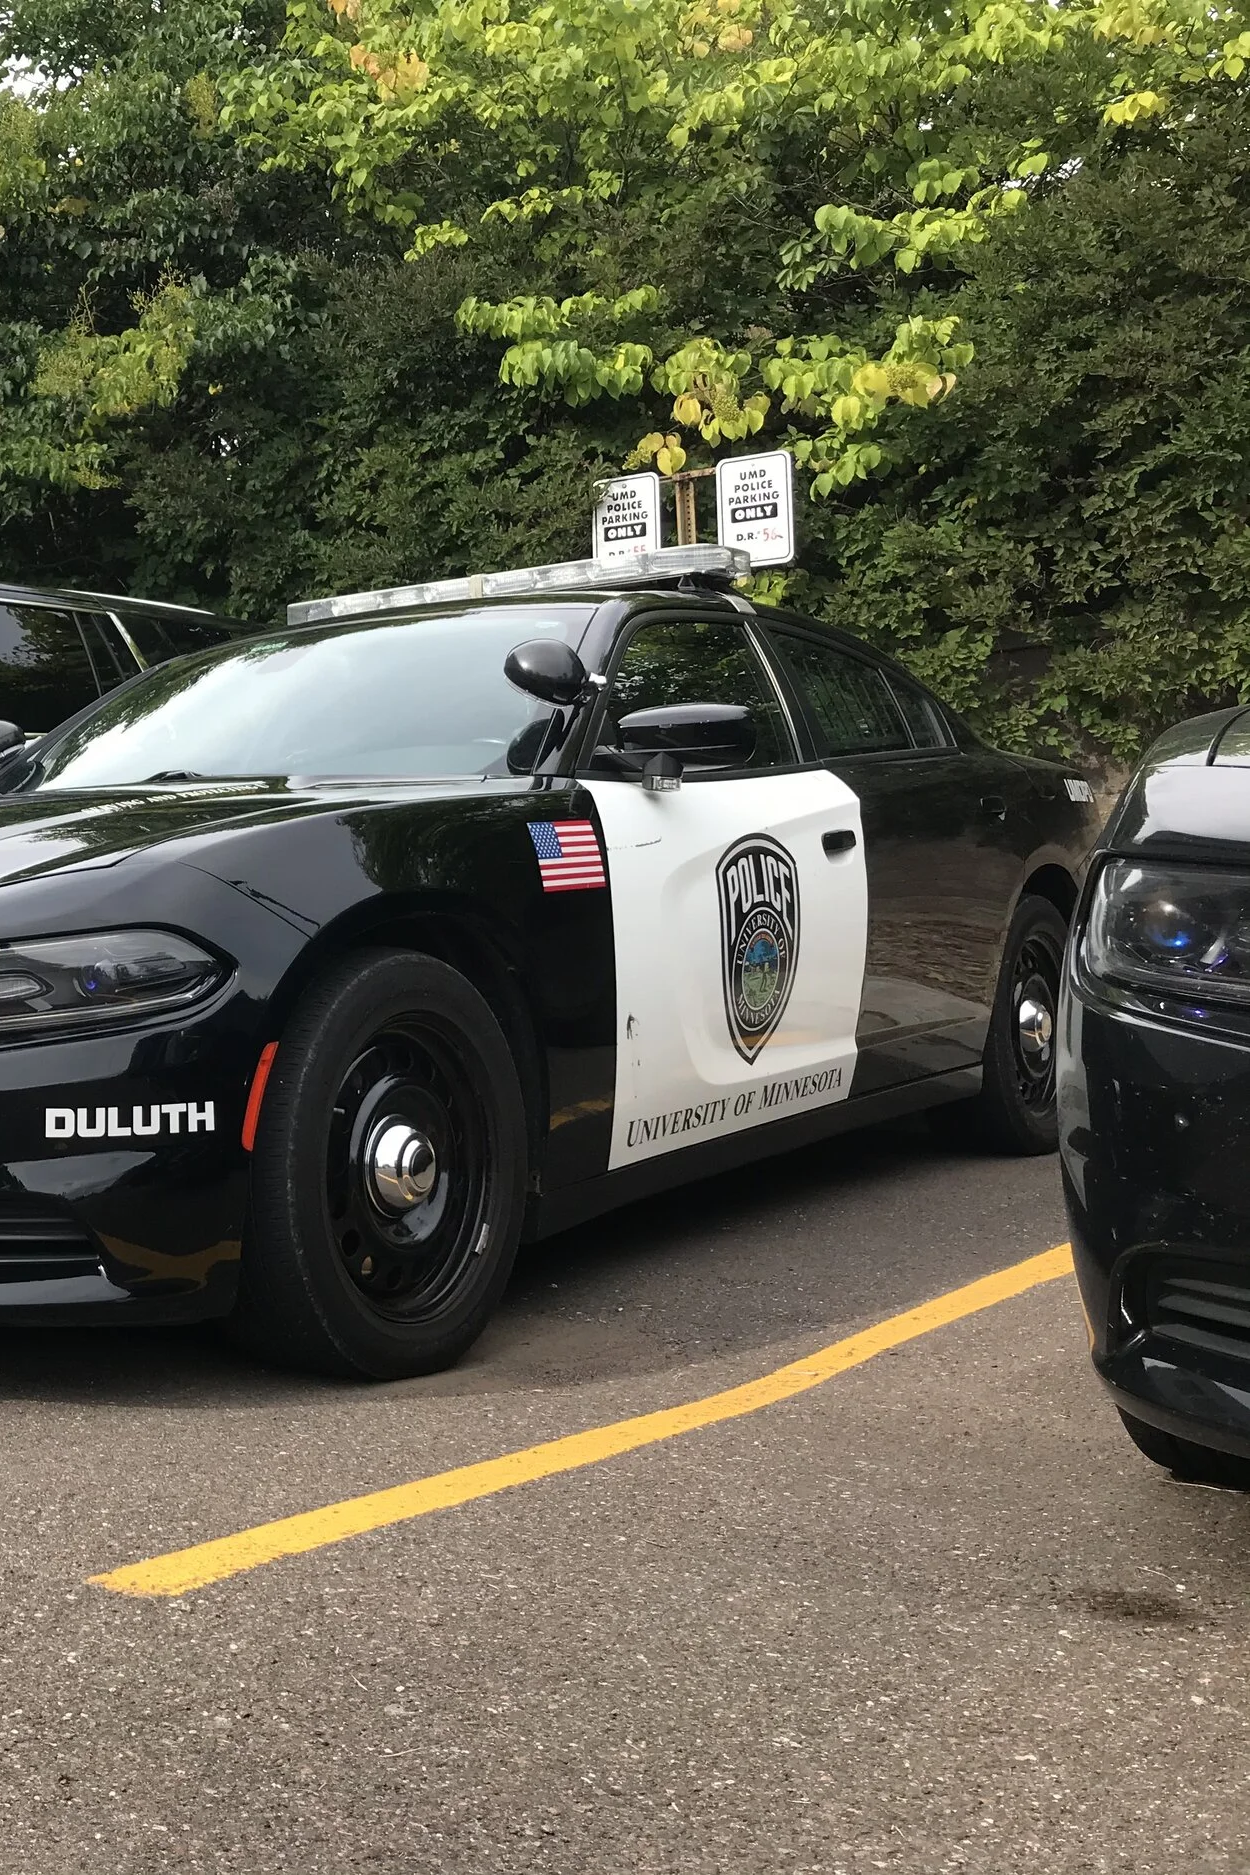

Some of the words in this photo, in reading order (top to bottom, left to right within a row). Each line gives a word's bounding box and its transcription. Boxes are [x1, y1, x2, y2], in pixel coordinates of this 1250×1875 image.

[739, 469, 767, 481] UMD
[734, 480, 773, 493] POLICE
[612, 490, 637, 501] UMD
[728, 491, 780, 506] PARKING
[607, 500, 643, 513] POLICE
[734, 504, 774, 521] ONLY
[601, 511, 649, 525] PARKING
[607, 524, 643, 539] ONLY
[726, 854, 793, 946] POLICE
[736, 913, 781, 965] UNIVERSITY
[777, 937, 786, 959] OF
[736, 989, 780, 1025] MINNESOTA
[626, 1097, 730, 1148] UNIVERSITY
[733, 1091, 756, 1117] OF
[758, 1067, 843, 1110] MINNESOTA
[45, 1100, 216, 1138] DULUTH
